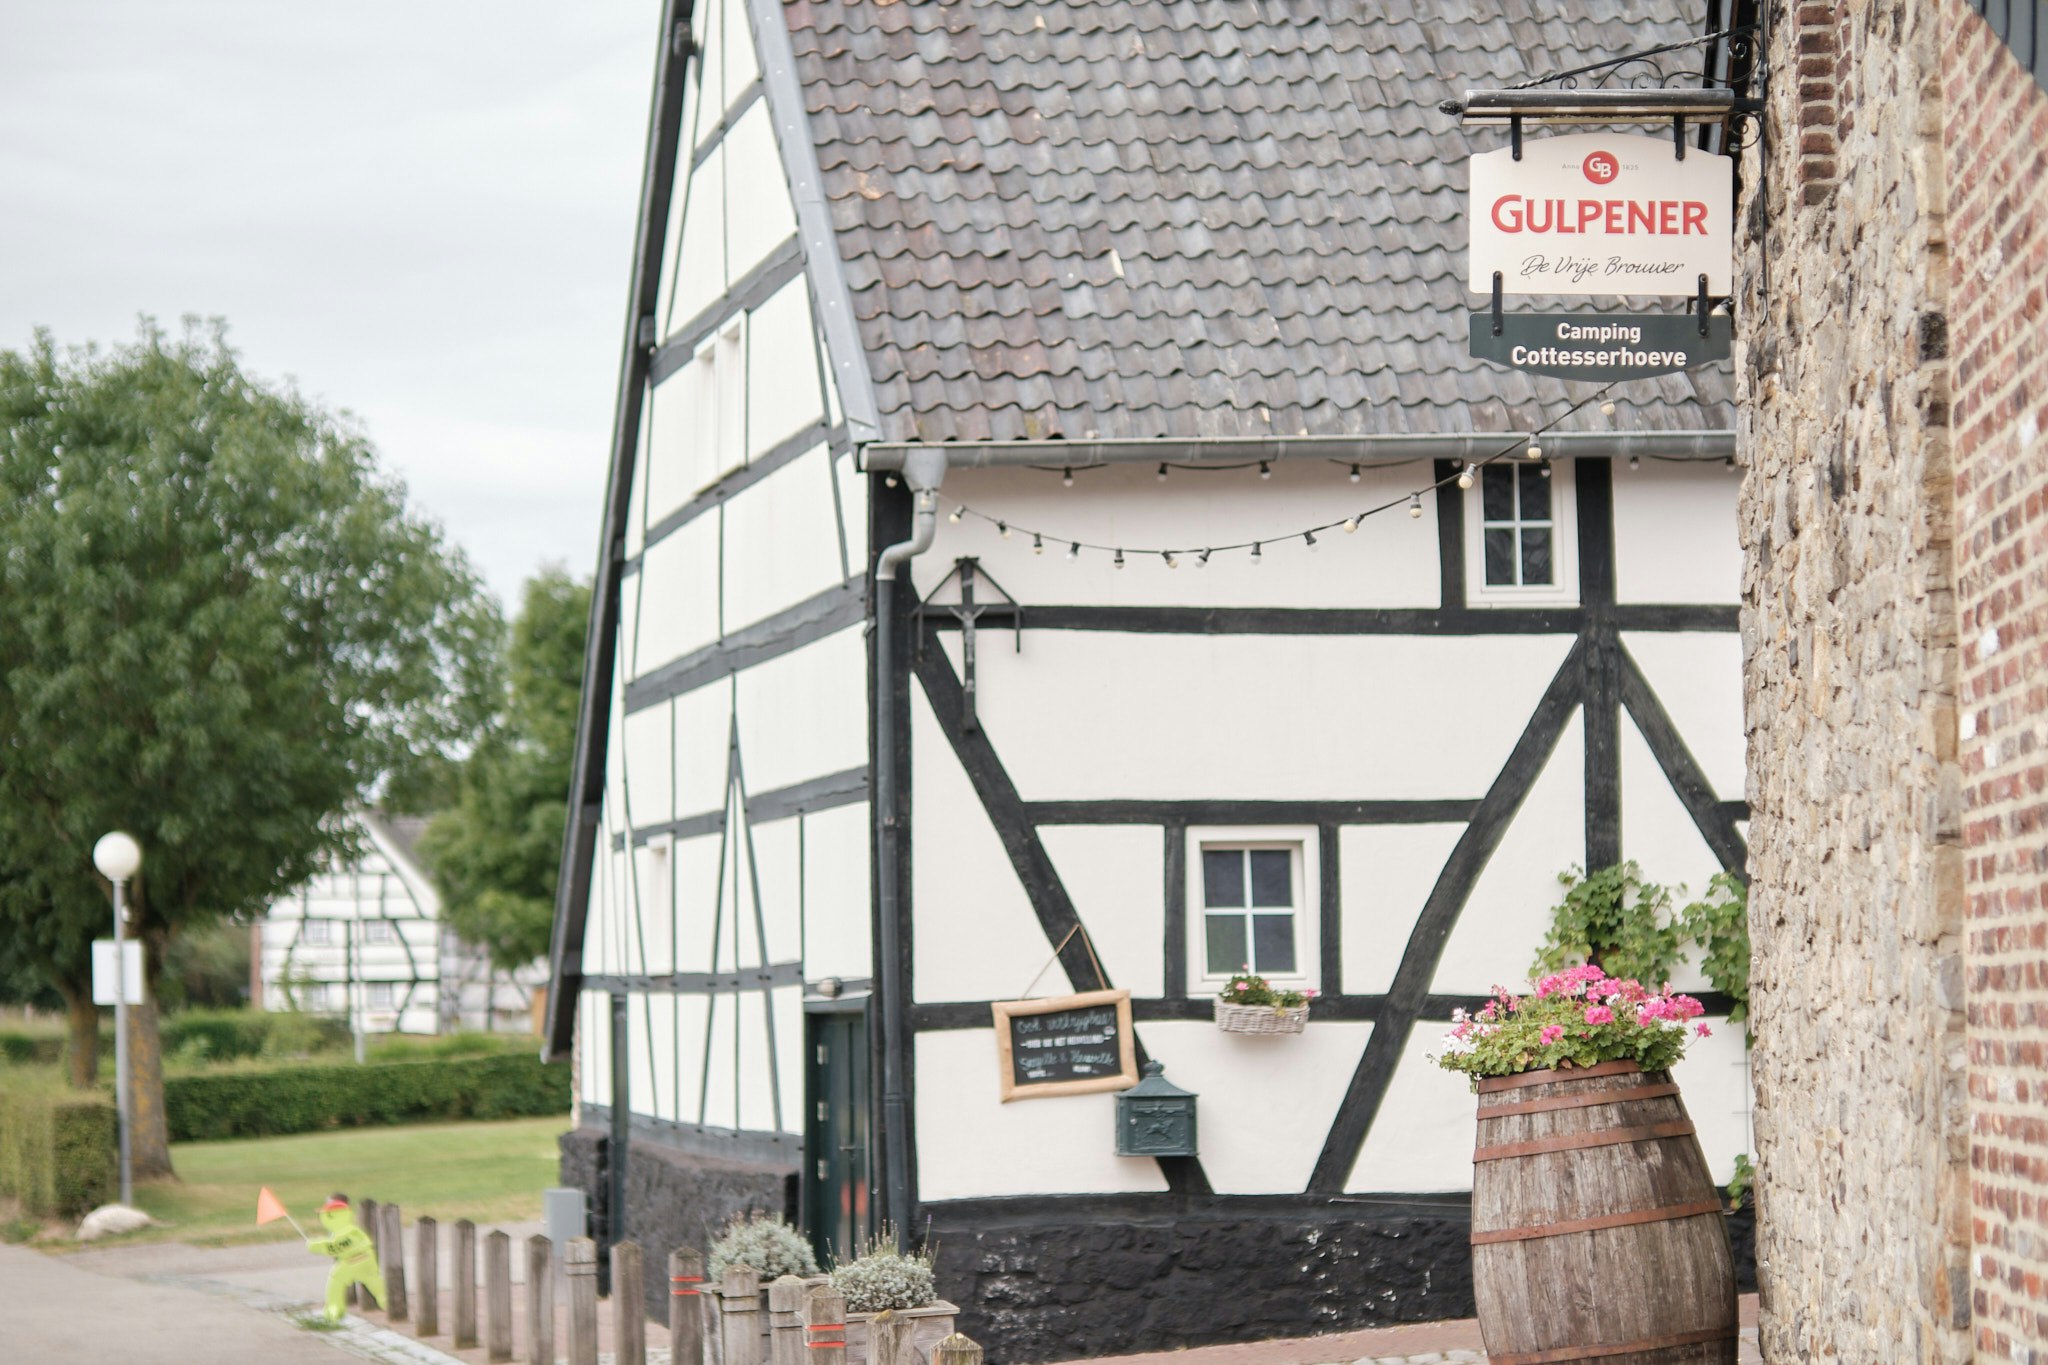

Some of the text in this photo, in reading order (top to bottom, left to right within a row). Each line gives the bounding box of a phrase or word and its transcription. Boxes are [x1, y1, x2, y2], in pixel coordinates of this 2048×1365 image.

[1589, 157, 1612, 178] GB
[1491, 194, 1708, 235] GULPENER
[1521, 255, 1684, 283] De Vrije Brouwer
[1557, 322, 1641, 344] Camping
[1512, 345, 1687, 366] Cottesserhoeve
